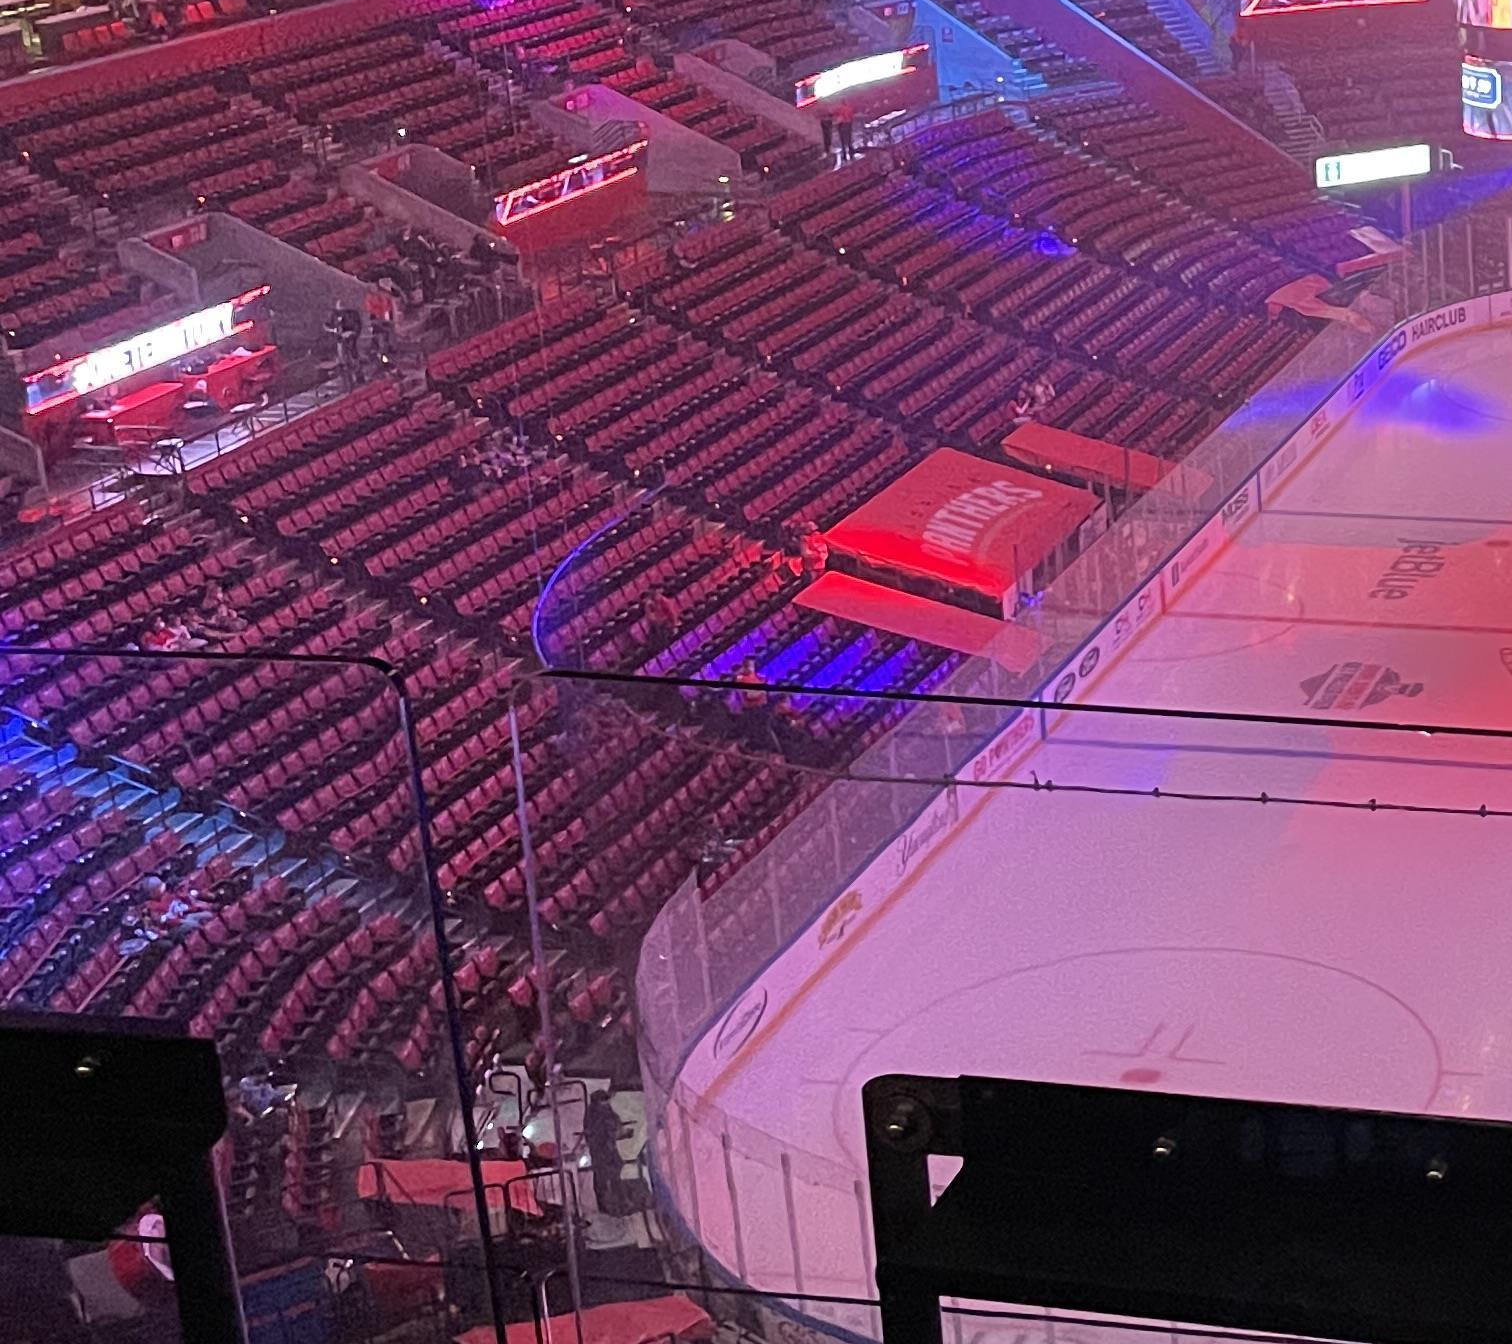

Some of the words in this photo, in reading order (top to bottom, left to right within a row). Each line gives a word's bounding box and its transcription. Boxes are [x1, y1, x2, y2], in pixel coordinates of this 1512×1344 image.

[1411, 306, 1467, 342] HAIRCLUB
[919, 479, 1043, 567] PANTHERS
[1369, 537, 1461, 600] jetBlue
